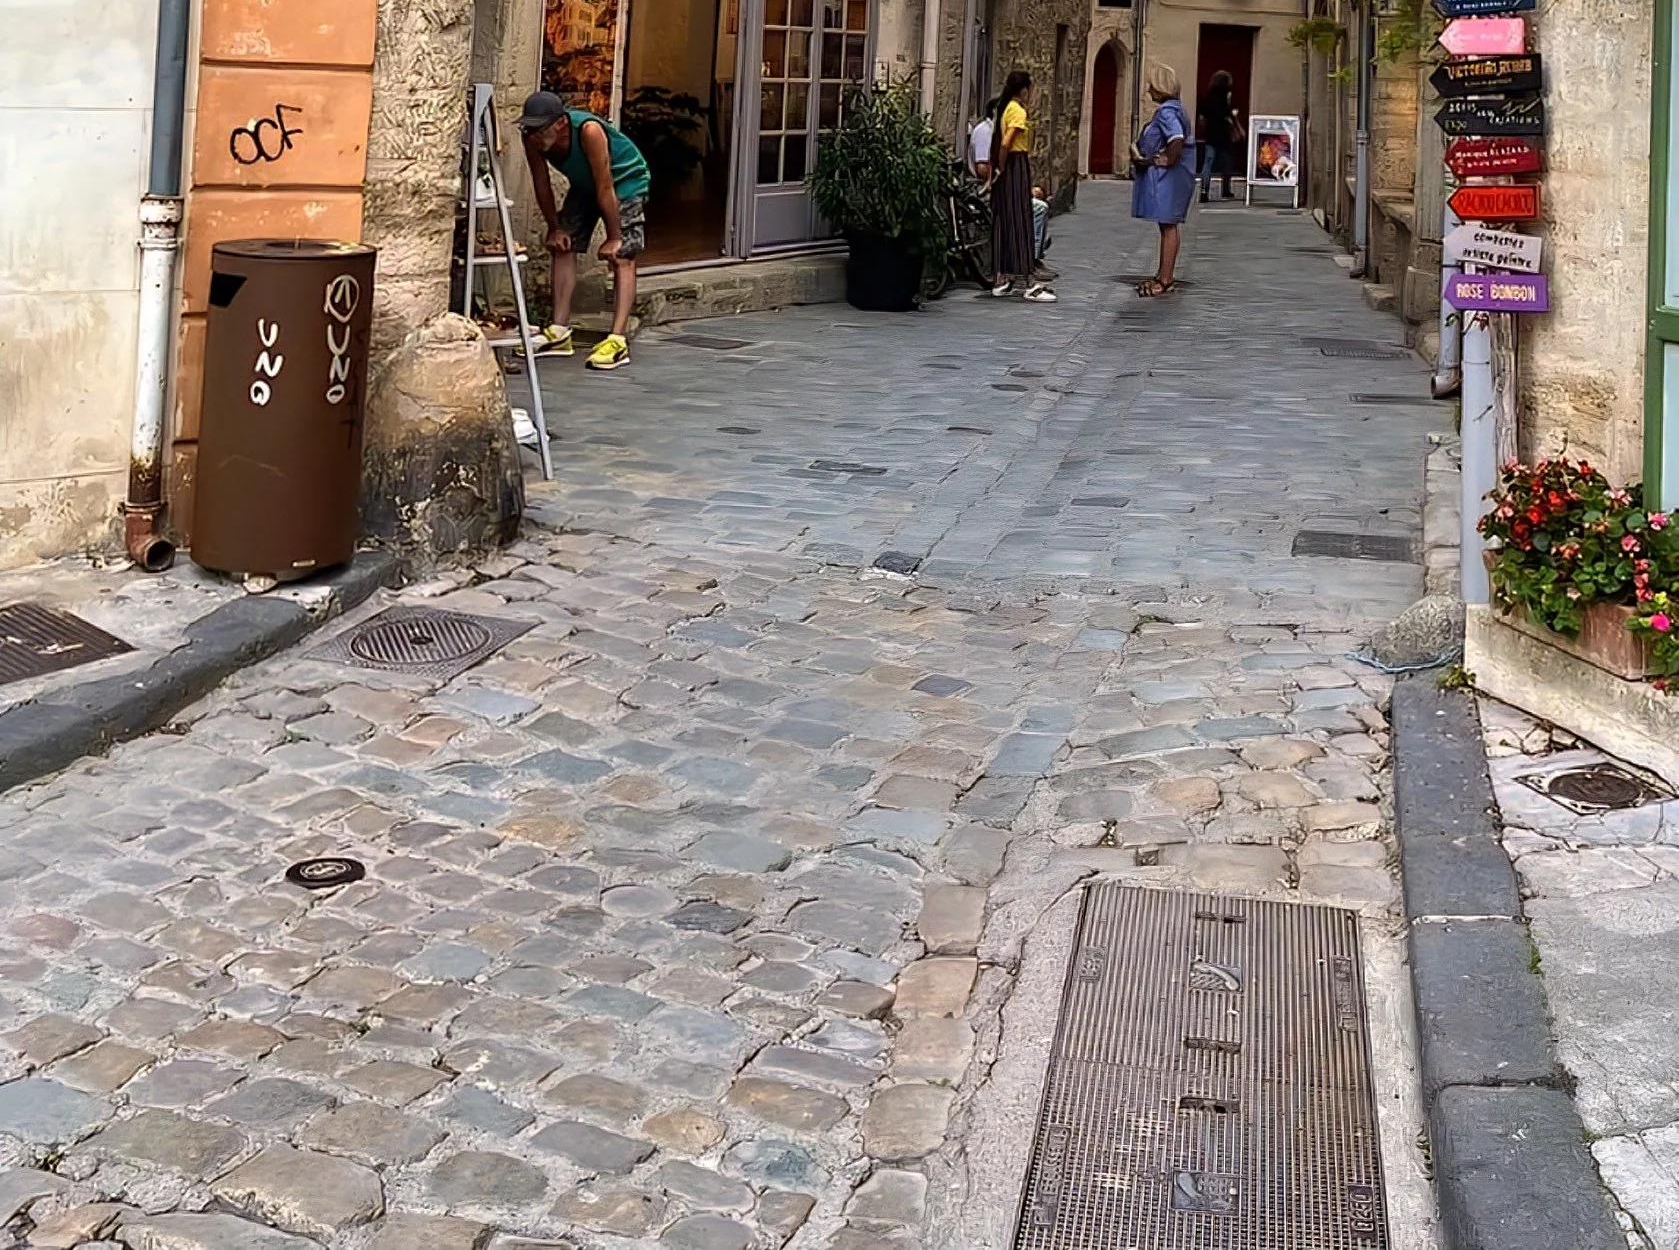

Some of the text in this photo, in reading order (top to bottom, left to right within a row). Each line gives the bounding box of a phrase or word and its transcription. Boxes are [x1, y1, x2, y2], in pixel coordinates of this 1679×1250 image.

[230, 103, 303, 165] OCF
[1456, 283, 1536, 302] ROSE BONBON
